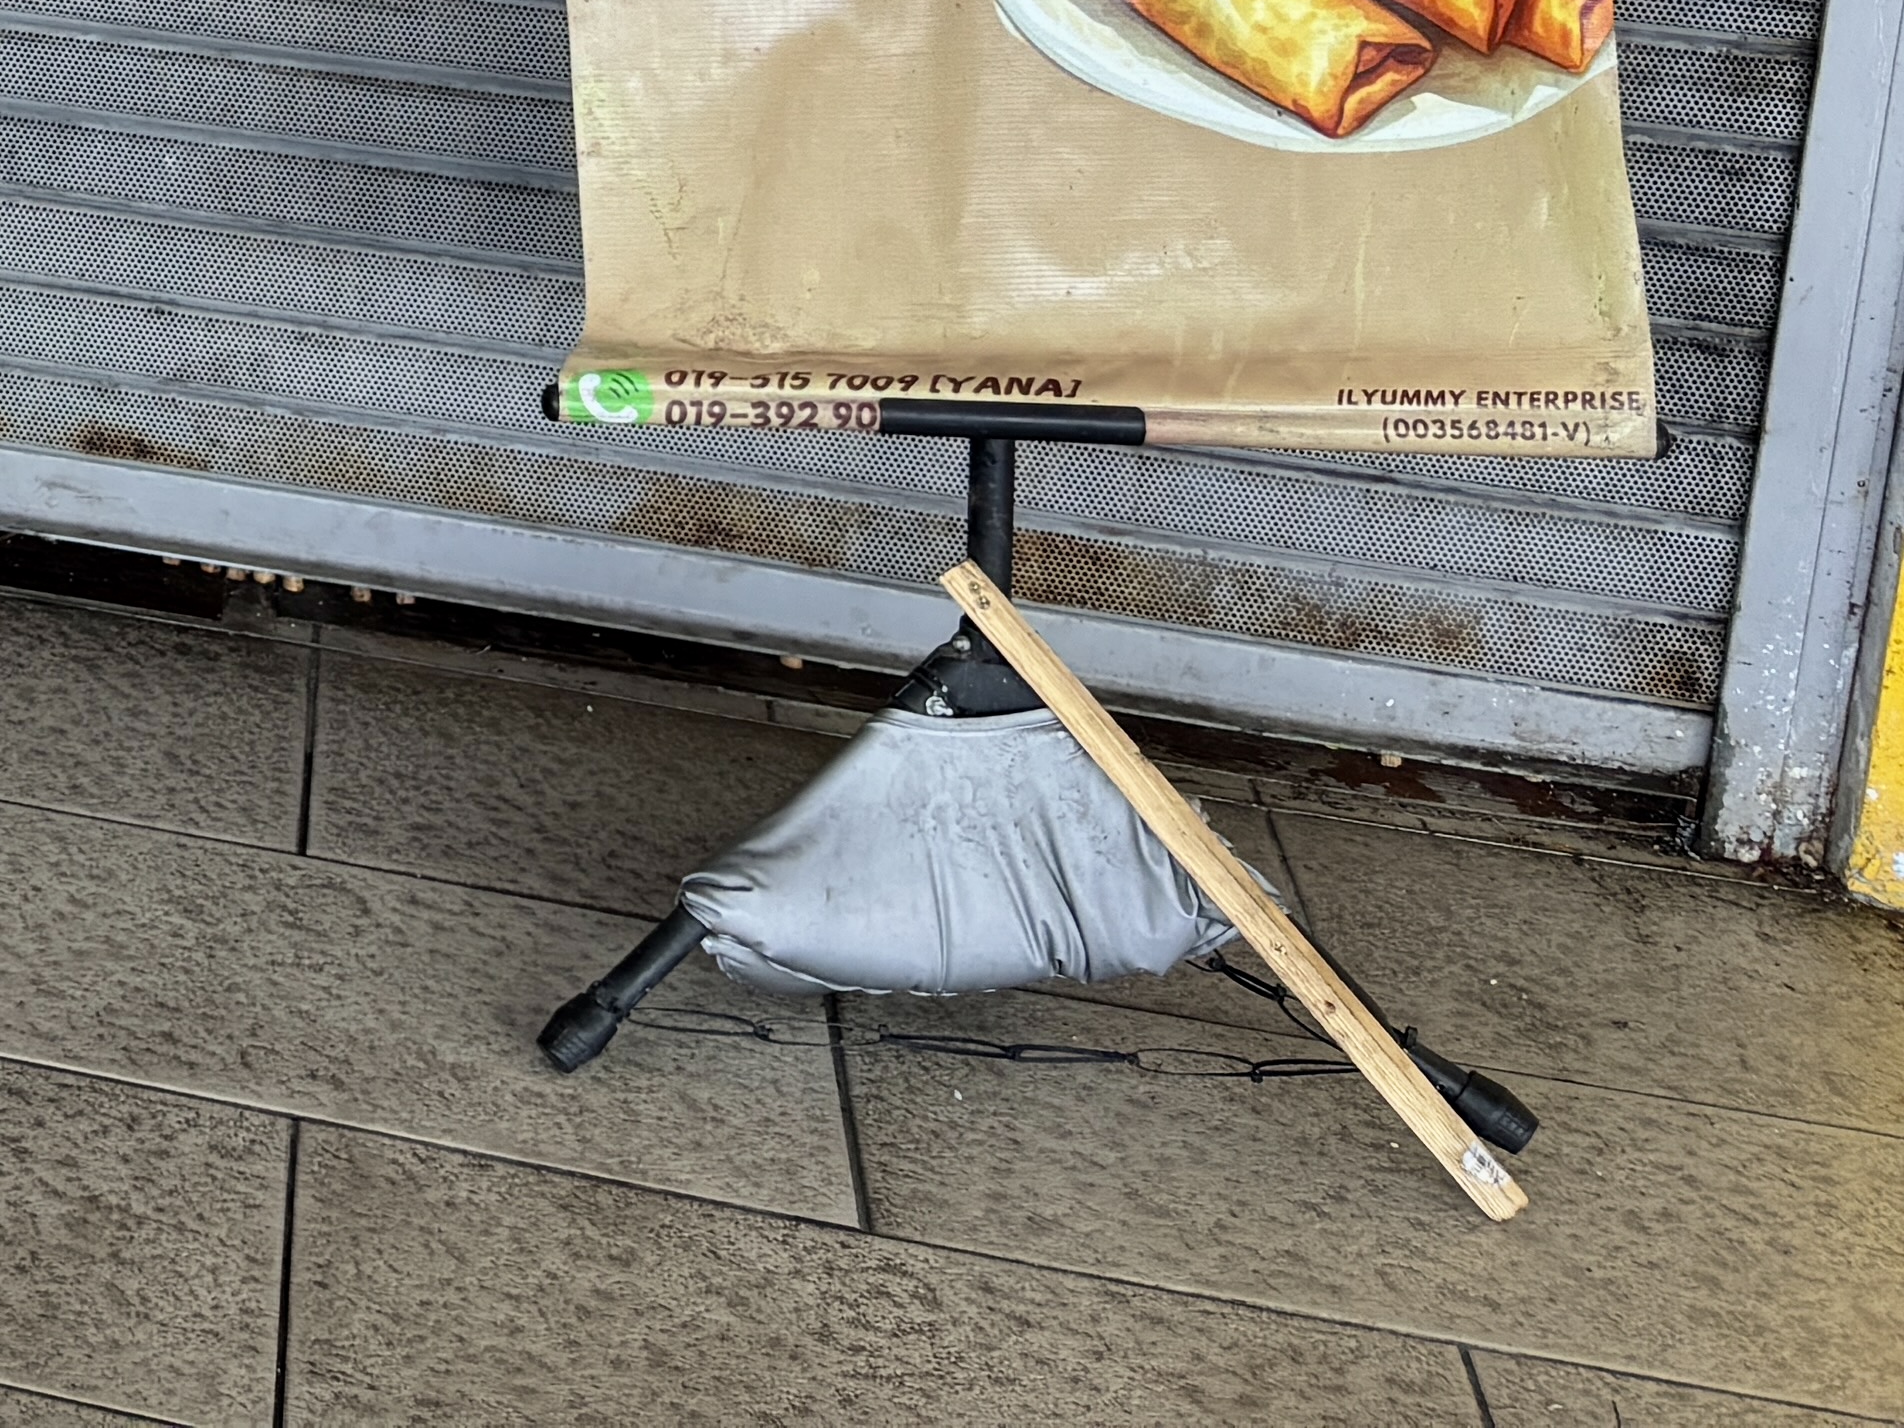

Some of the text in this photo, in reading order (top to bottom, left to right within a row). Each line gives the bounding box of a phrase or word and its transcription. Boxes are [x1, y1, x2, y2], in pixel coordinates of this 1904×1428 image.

[1336, 388, 1642, 411] ILYUMMY ENTERPRISE
[664, 400, 819, 429] 019-392
